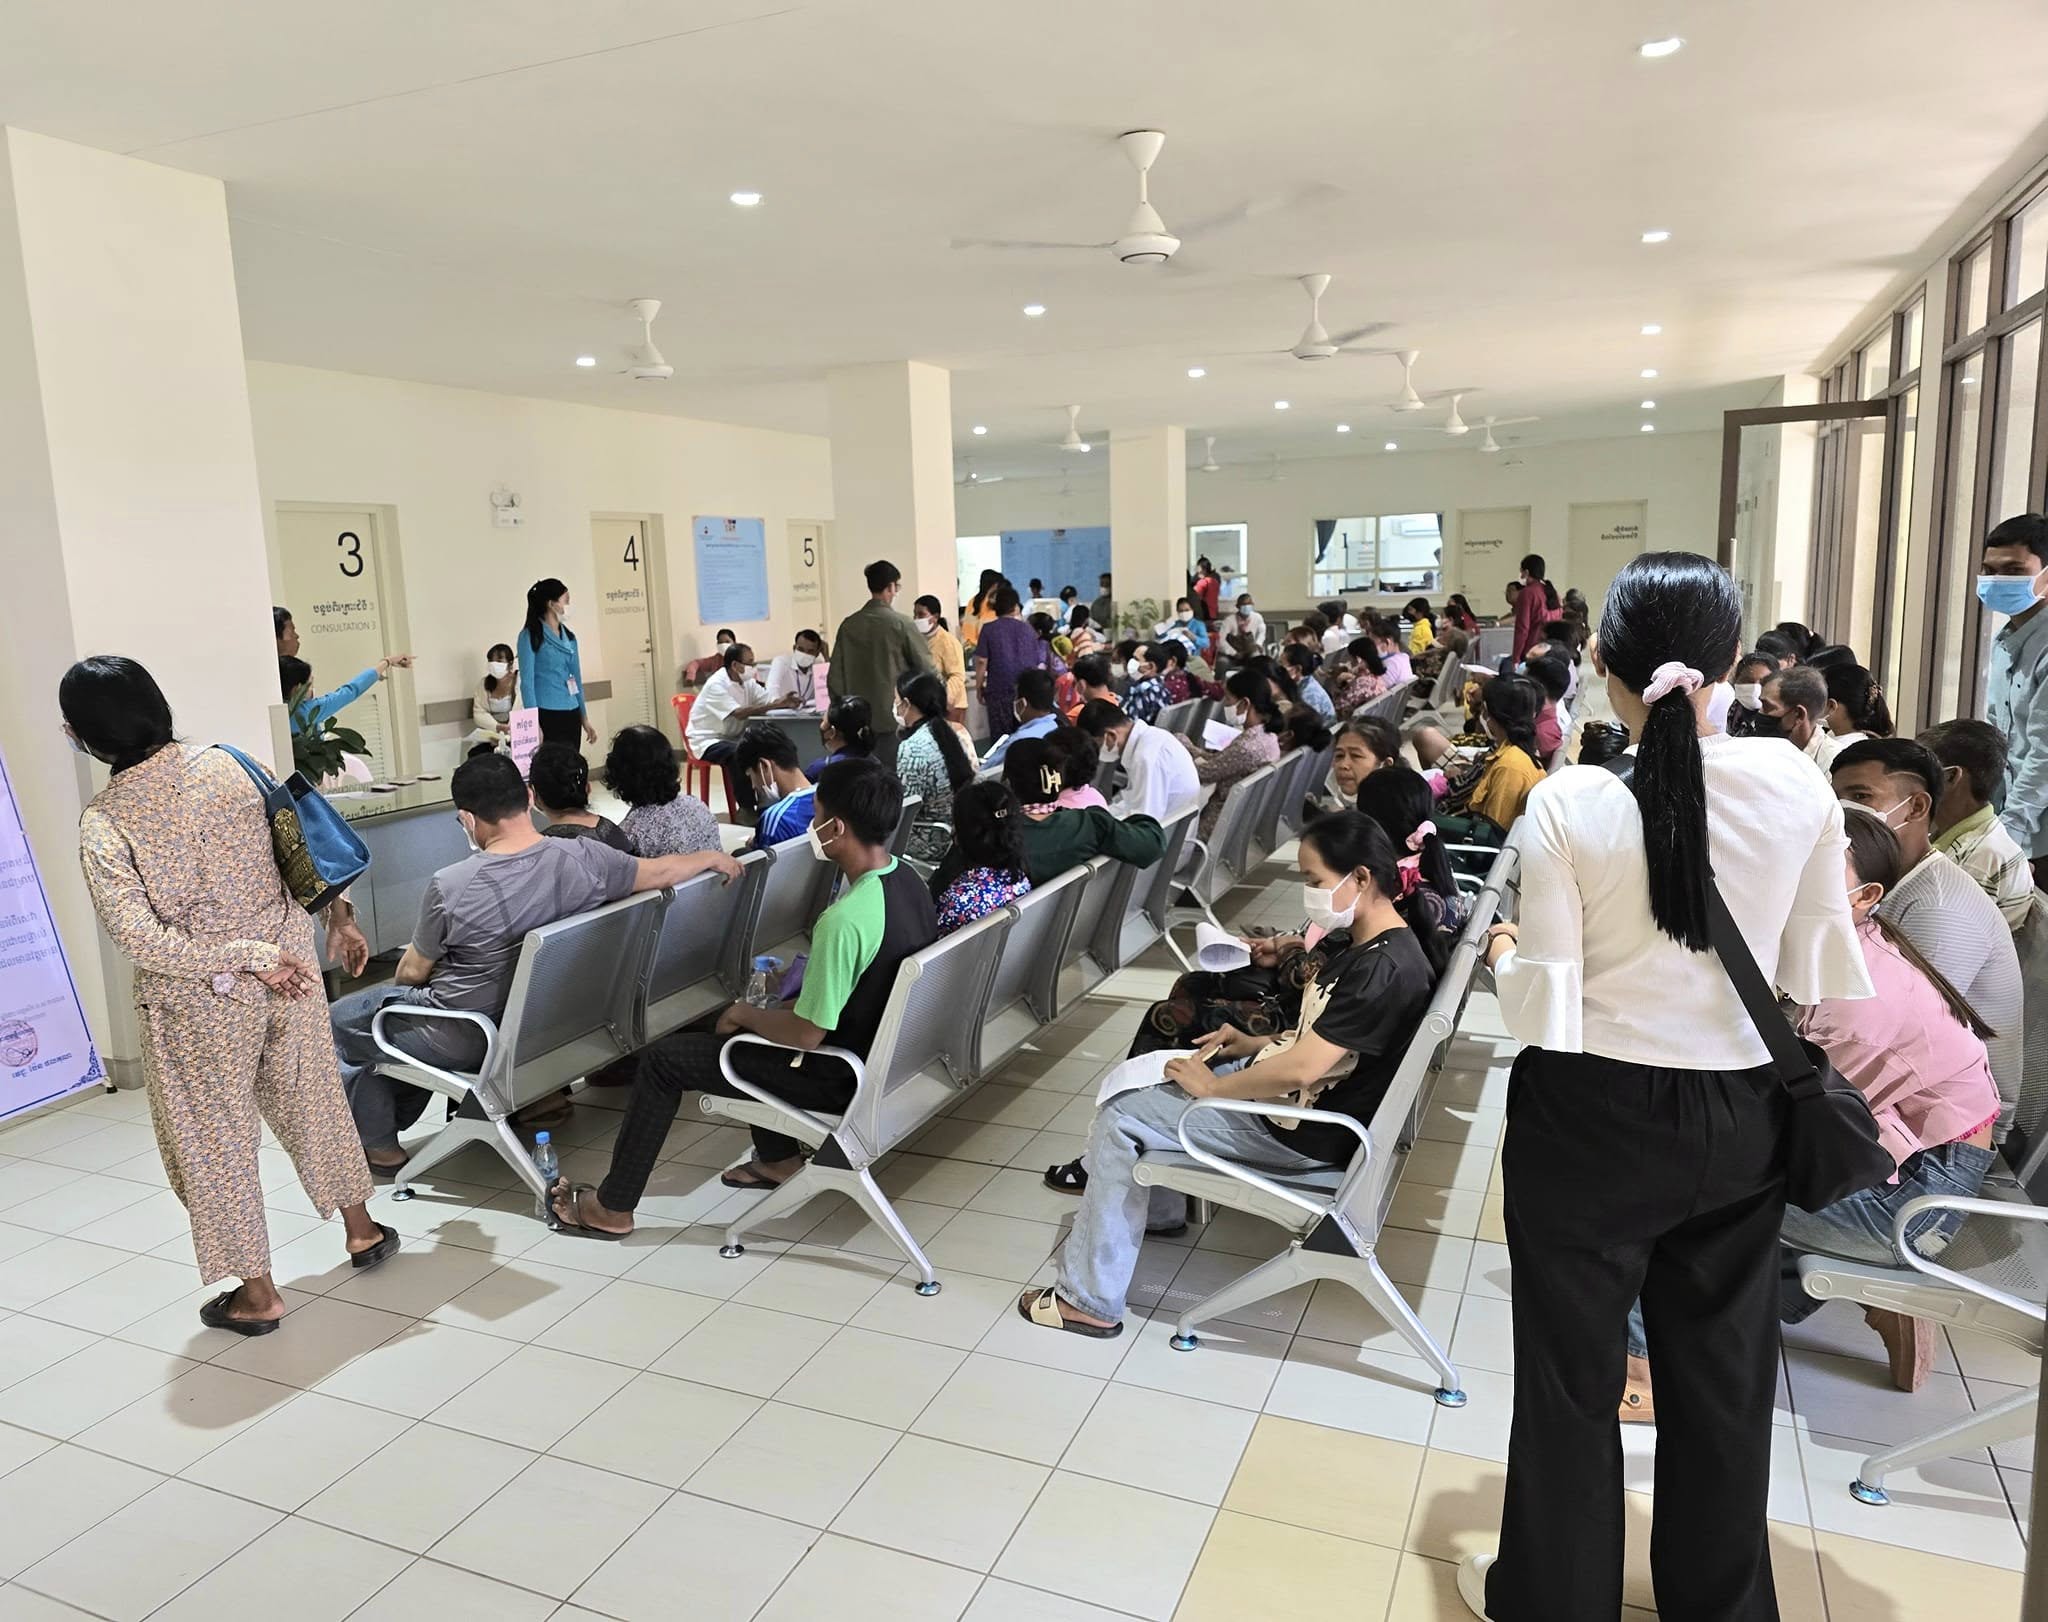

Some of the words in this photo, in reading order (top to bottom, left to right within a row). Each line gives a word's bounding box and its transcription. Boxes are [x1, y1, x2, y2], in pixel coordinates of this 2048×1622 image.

[337, 531, 364, 578] 3
[623, 535, 640, 572] 4
[803, 537, 815, 568] 5
[310, 621, 370, 634] CONSULTATION
[371, 620, 377, 631] 3
